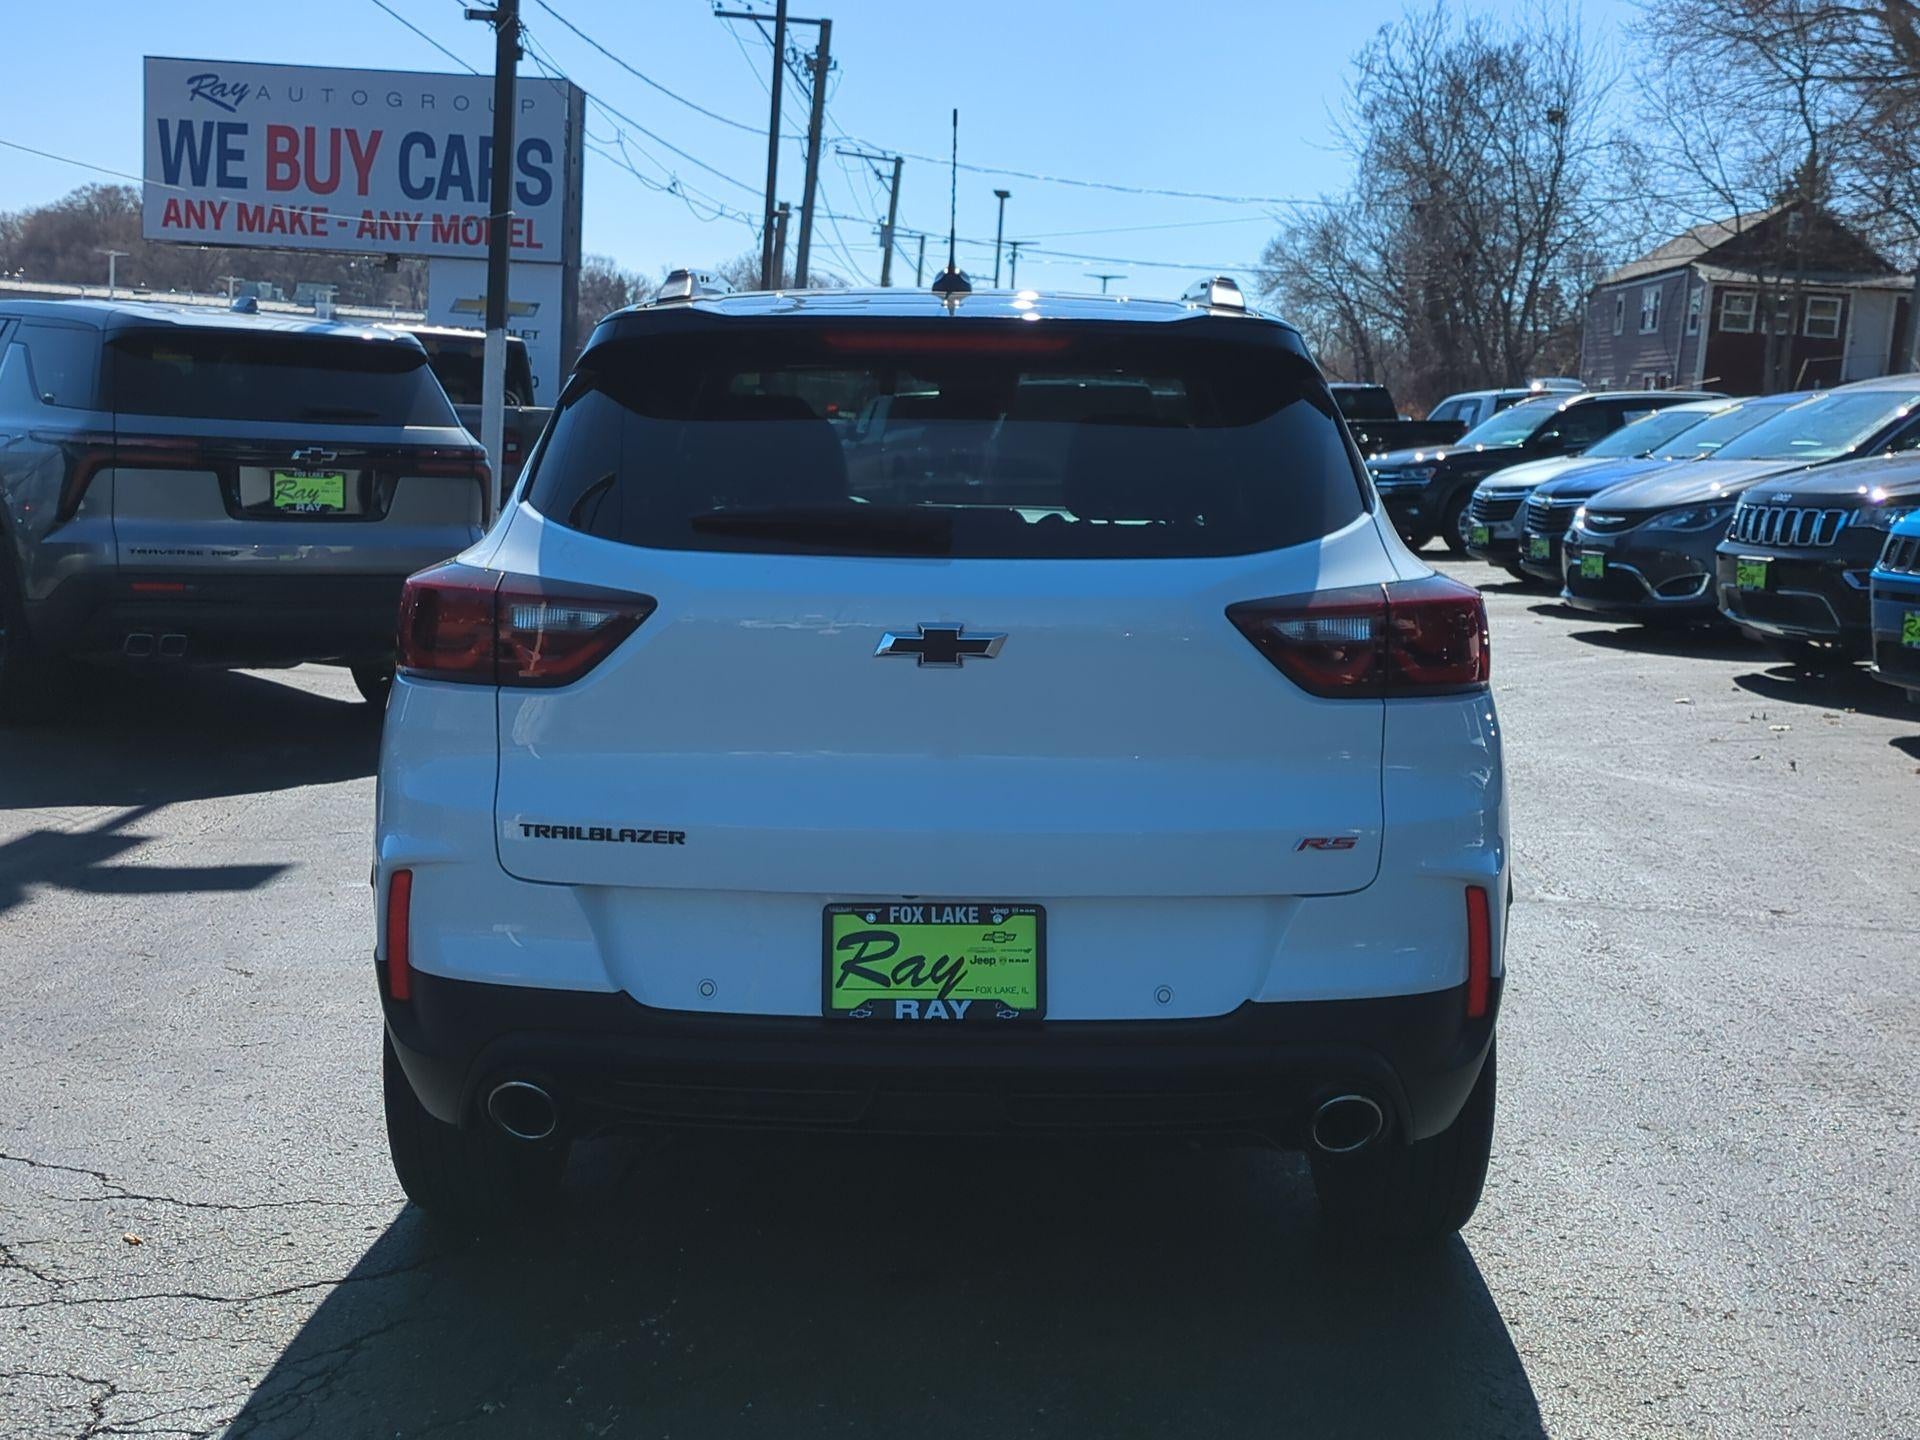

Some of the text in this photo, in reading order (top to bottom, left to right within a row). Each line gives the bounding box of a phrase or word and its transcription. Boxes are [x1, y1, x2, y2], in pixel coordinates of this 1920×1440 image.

[187, 73, 250, 113] Ray
[157, 118, 248, 189] WE
[266, 124, 383, 196] BUY
[162, 198, 228, 231] ANY
[237, 202, 329, 237] MAKE
[356, 208, 423, 242] ANY
[275, 480, 320, 504] Ray
[296, 503, 321, 512] RAY
[519, 823, 686, 845] TRAILBLAZER
[1296, 836, 1359, 852] RS
[889, 906, 979, 924] FOX LAKE
[990, 907, 1009, 915] Jeep
[835, 930, 968, 999] Ray
[969, 955, 996, 967] Jeep
[975, 986, 1029, 995] FOX LAKE, IL
[895, 1000, 972, 1020] RAY
